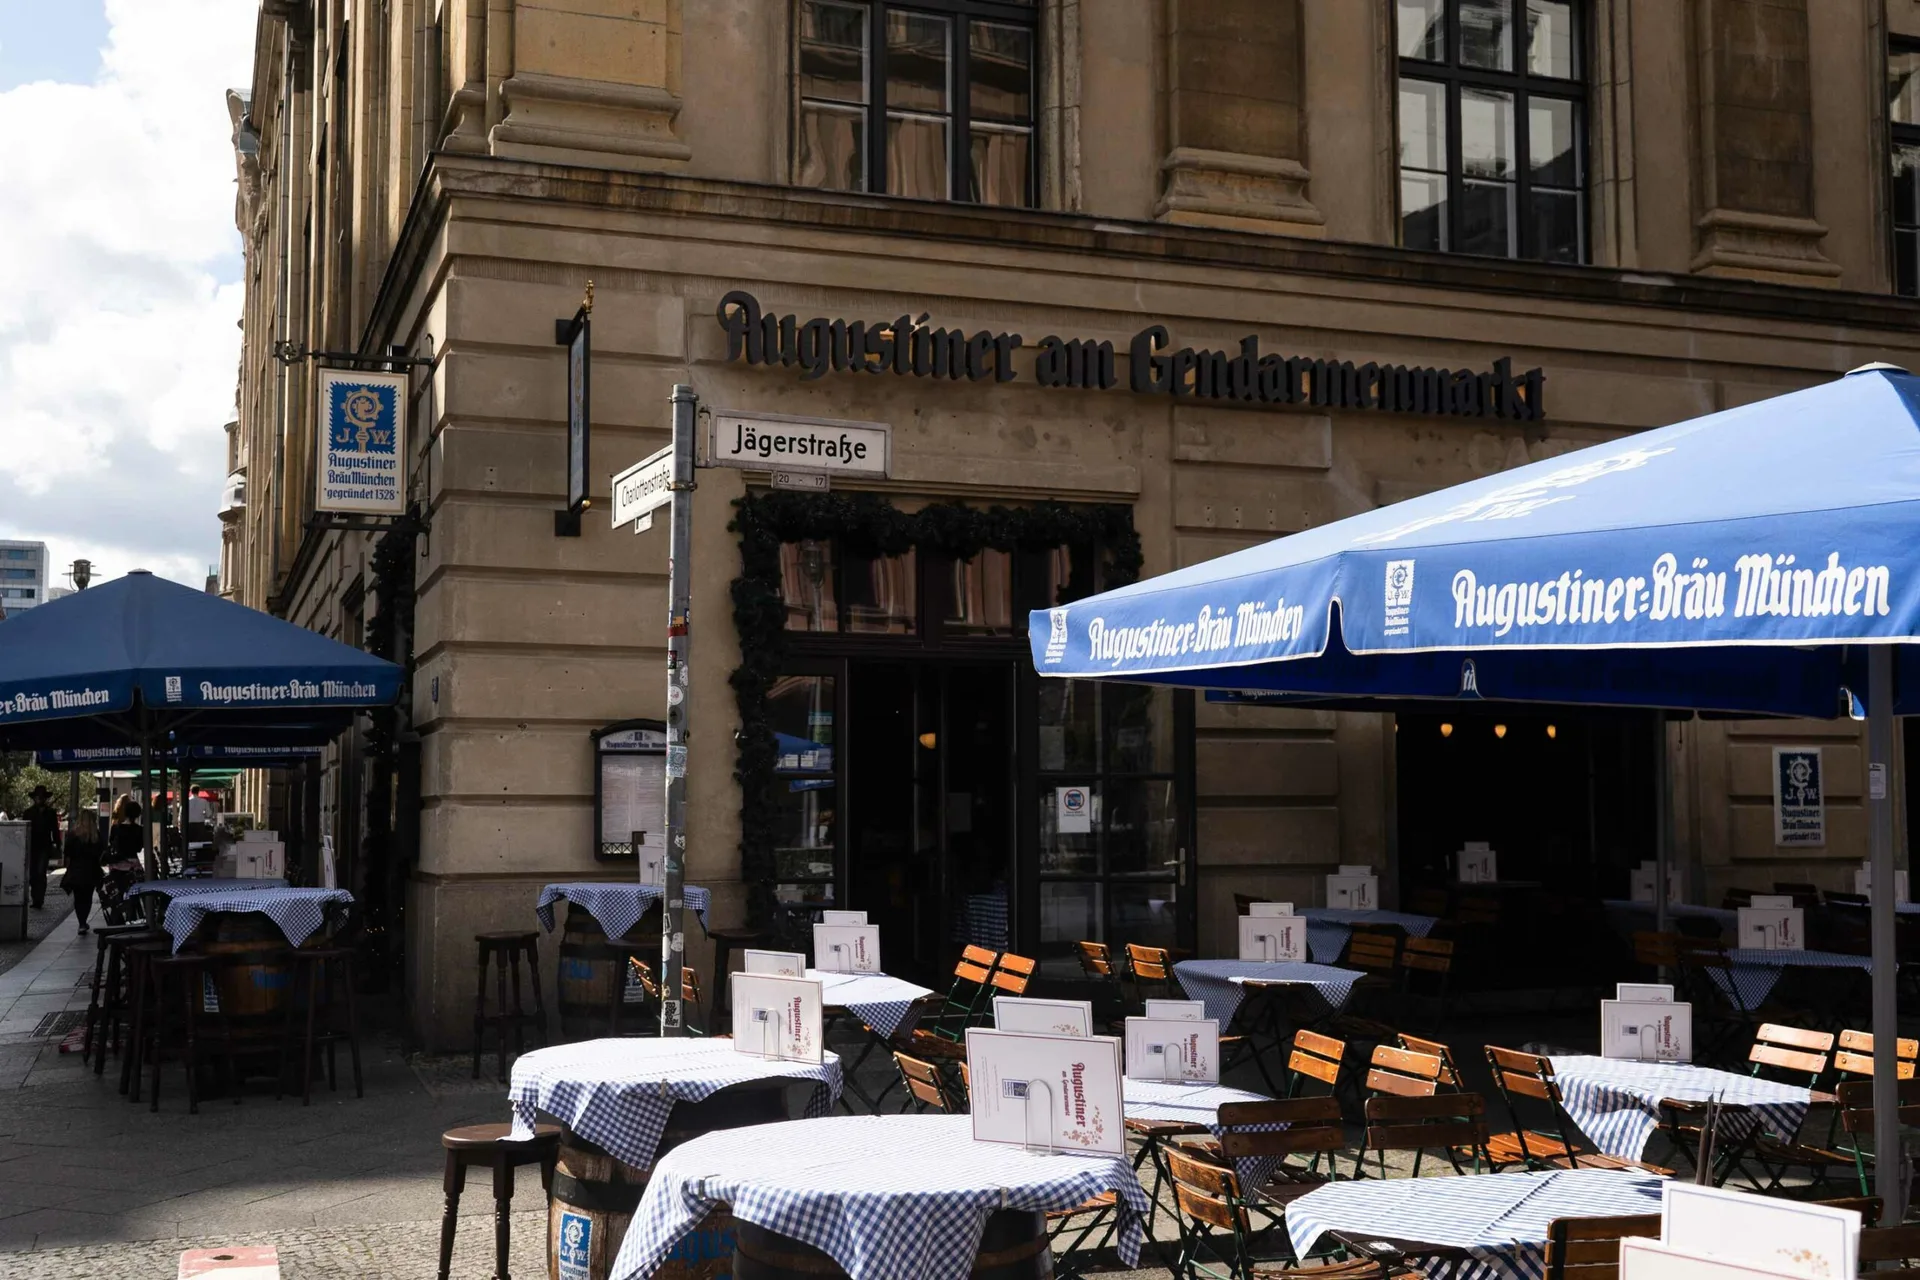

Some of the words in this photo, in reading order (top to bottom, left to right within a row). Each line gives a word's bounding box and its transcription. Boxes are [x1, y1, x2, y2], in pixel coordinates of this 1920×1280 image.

[717, 290, 1022, 382] Augustiner
[1036, 335, 1118, 390] am
[1130, 325, 1547, 421] Gendarmenmarkt
[731, 424, 867, 463] Jägerstraße
[327, 488, 373, 500] gegründet
[375, 489, 395, 500] 1328
[622, 464, 670, 507] Charlottenstraße
[777, 473, 790, 484] 20
[814, 477, 824, 486] 17
[1734, 551, 1890, 618] München
[1235, 596, 1304, 649] München
[50, 687, 109, 709] München
[321, 680, 376, 698] München
[1071, 1062, 1086, 1127] Augustiner
